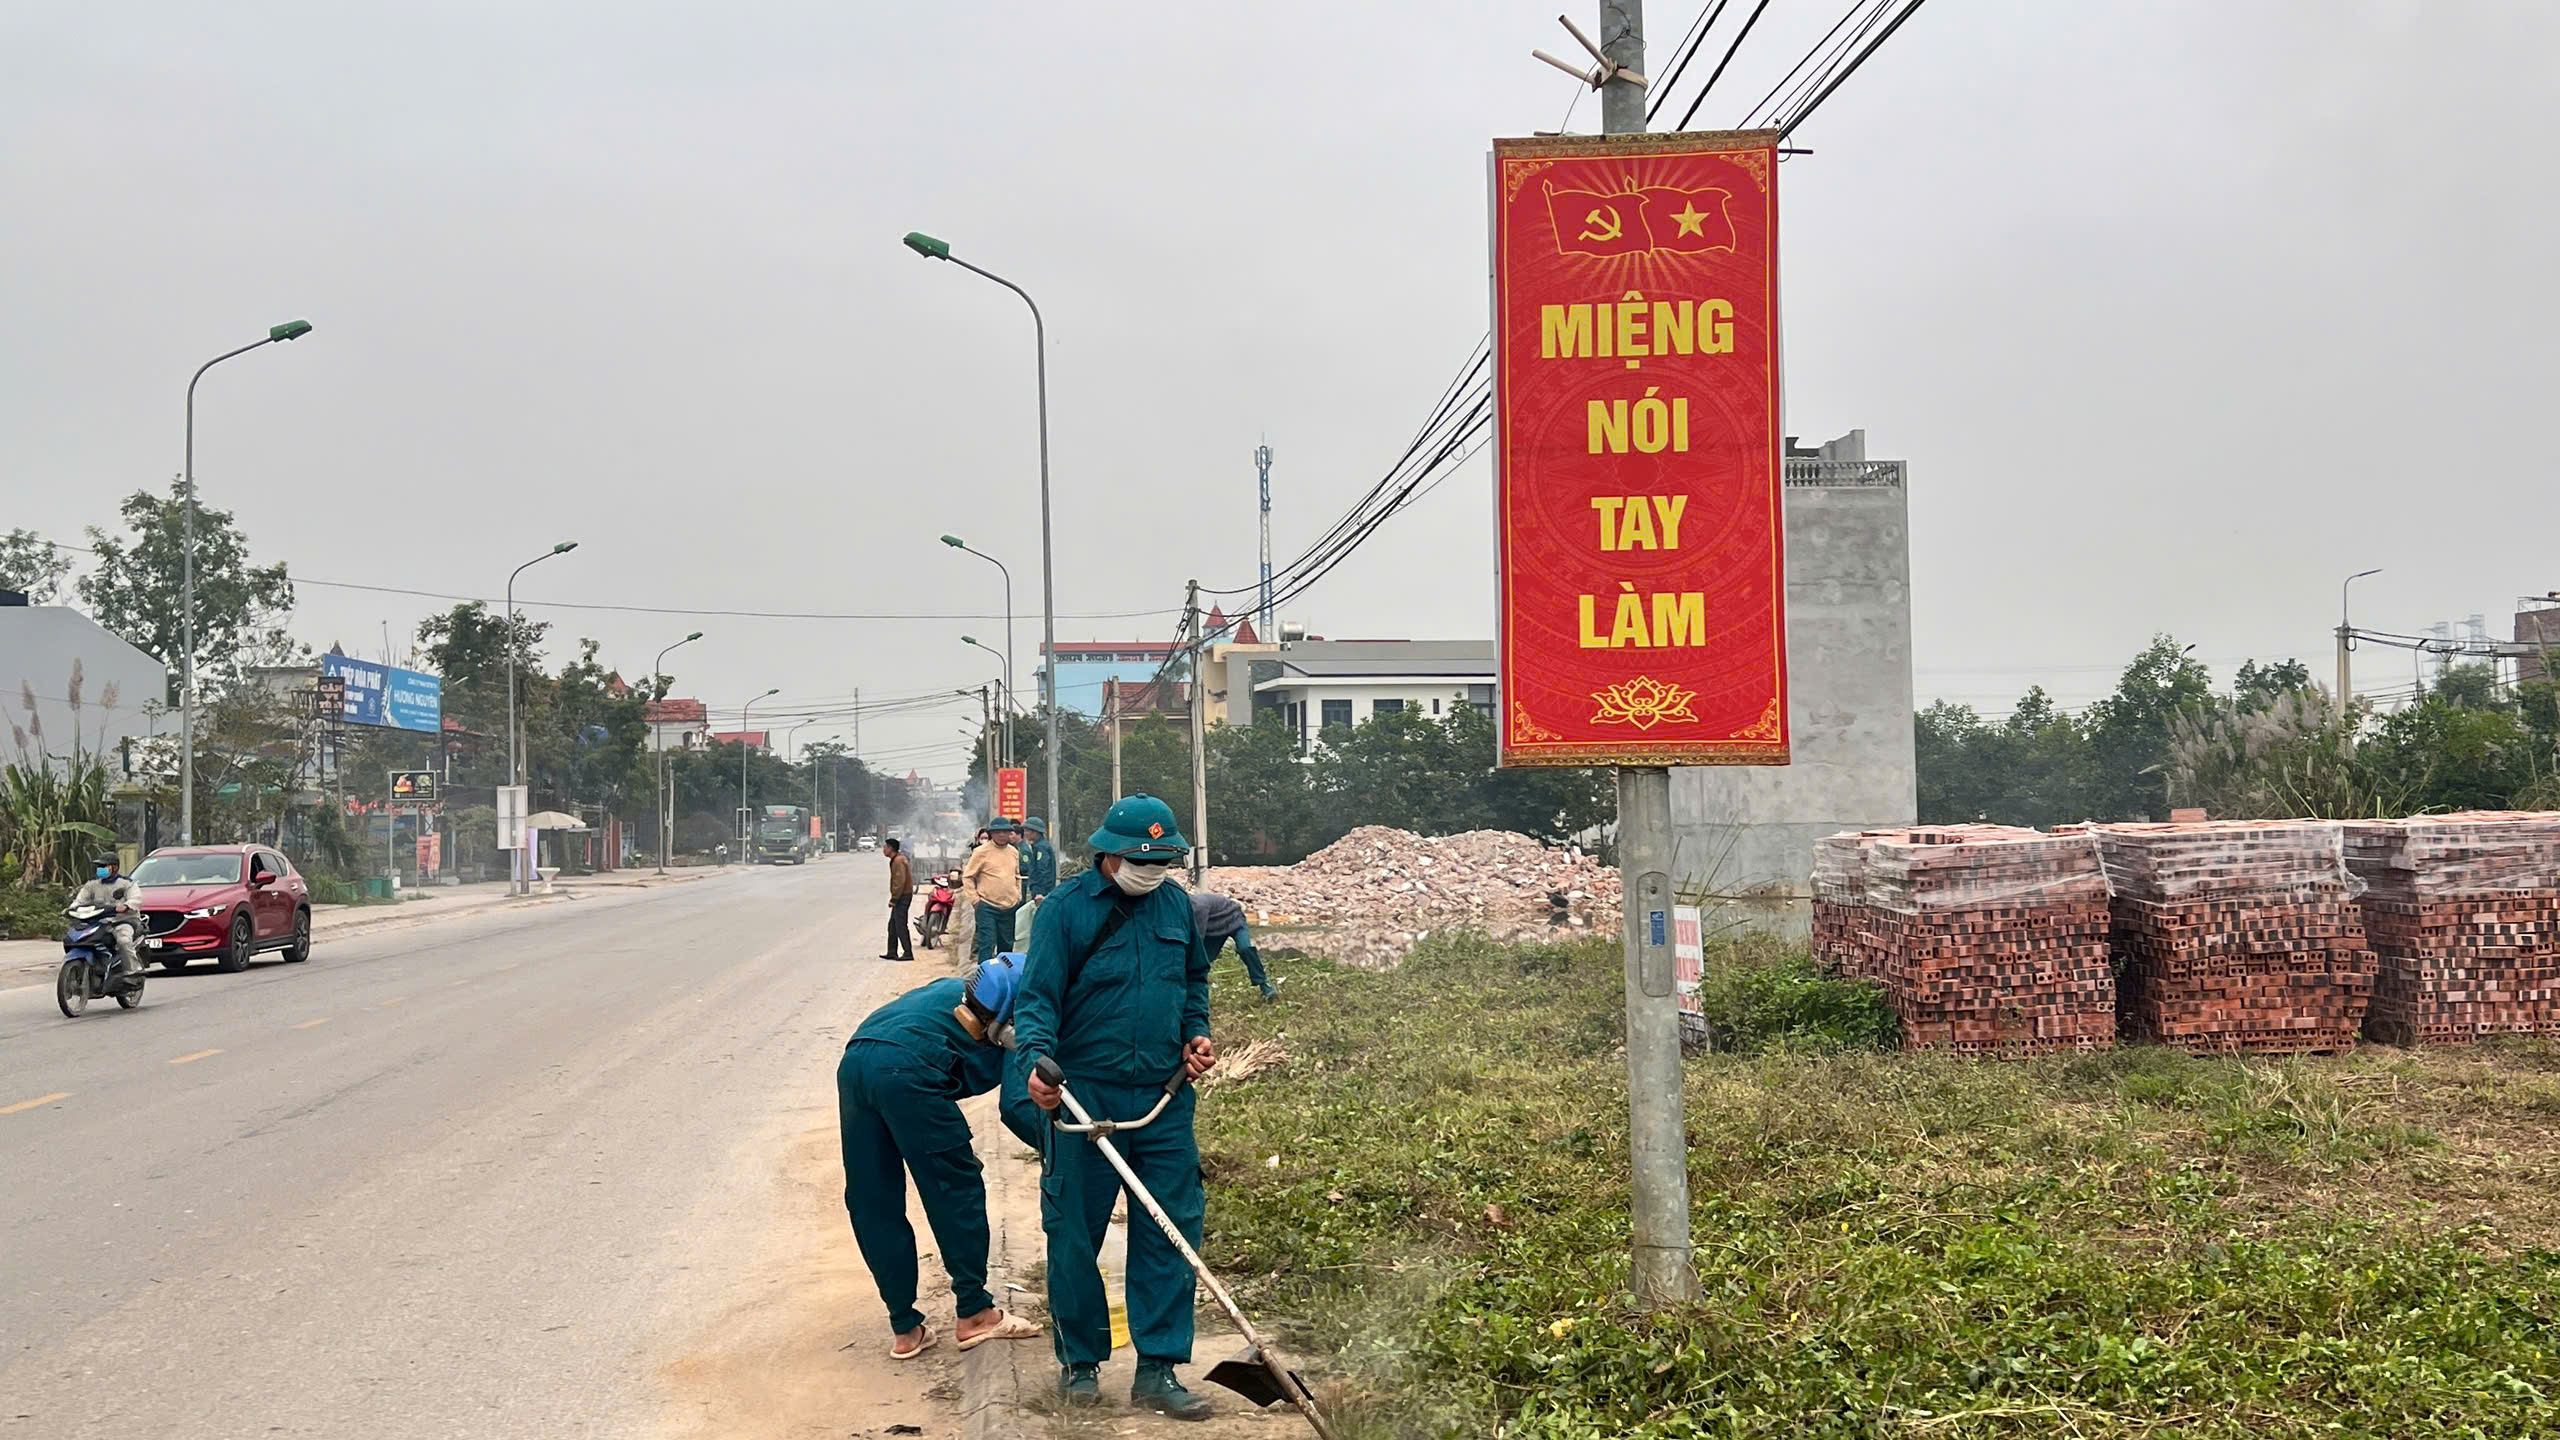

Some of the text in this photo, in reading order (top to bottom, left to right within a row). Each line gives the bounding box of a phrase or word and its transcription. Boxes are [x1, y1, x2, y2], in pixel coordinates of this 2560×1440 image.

[1541, 290, 1735, 369] MIỆNG
[1587, 386, 1689, 454] NÓI
[1591, 495, 1688, 551] TAY
[1579, 581, 1706, 648] LÀM
